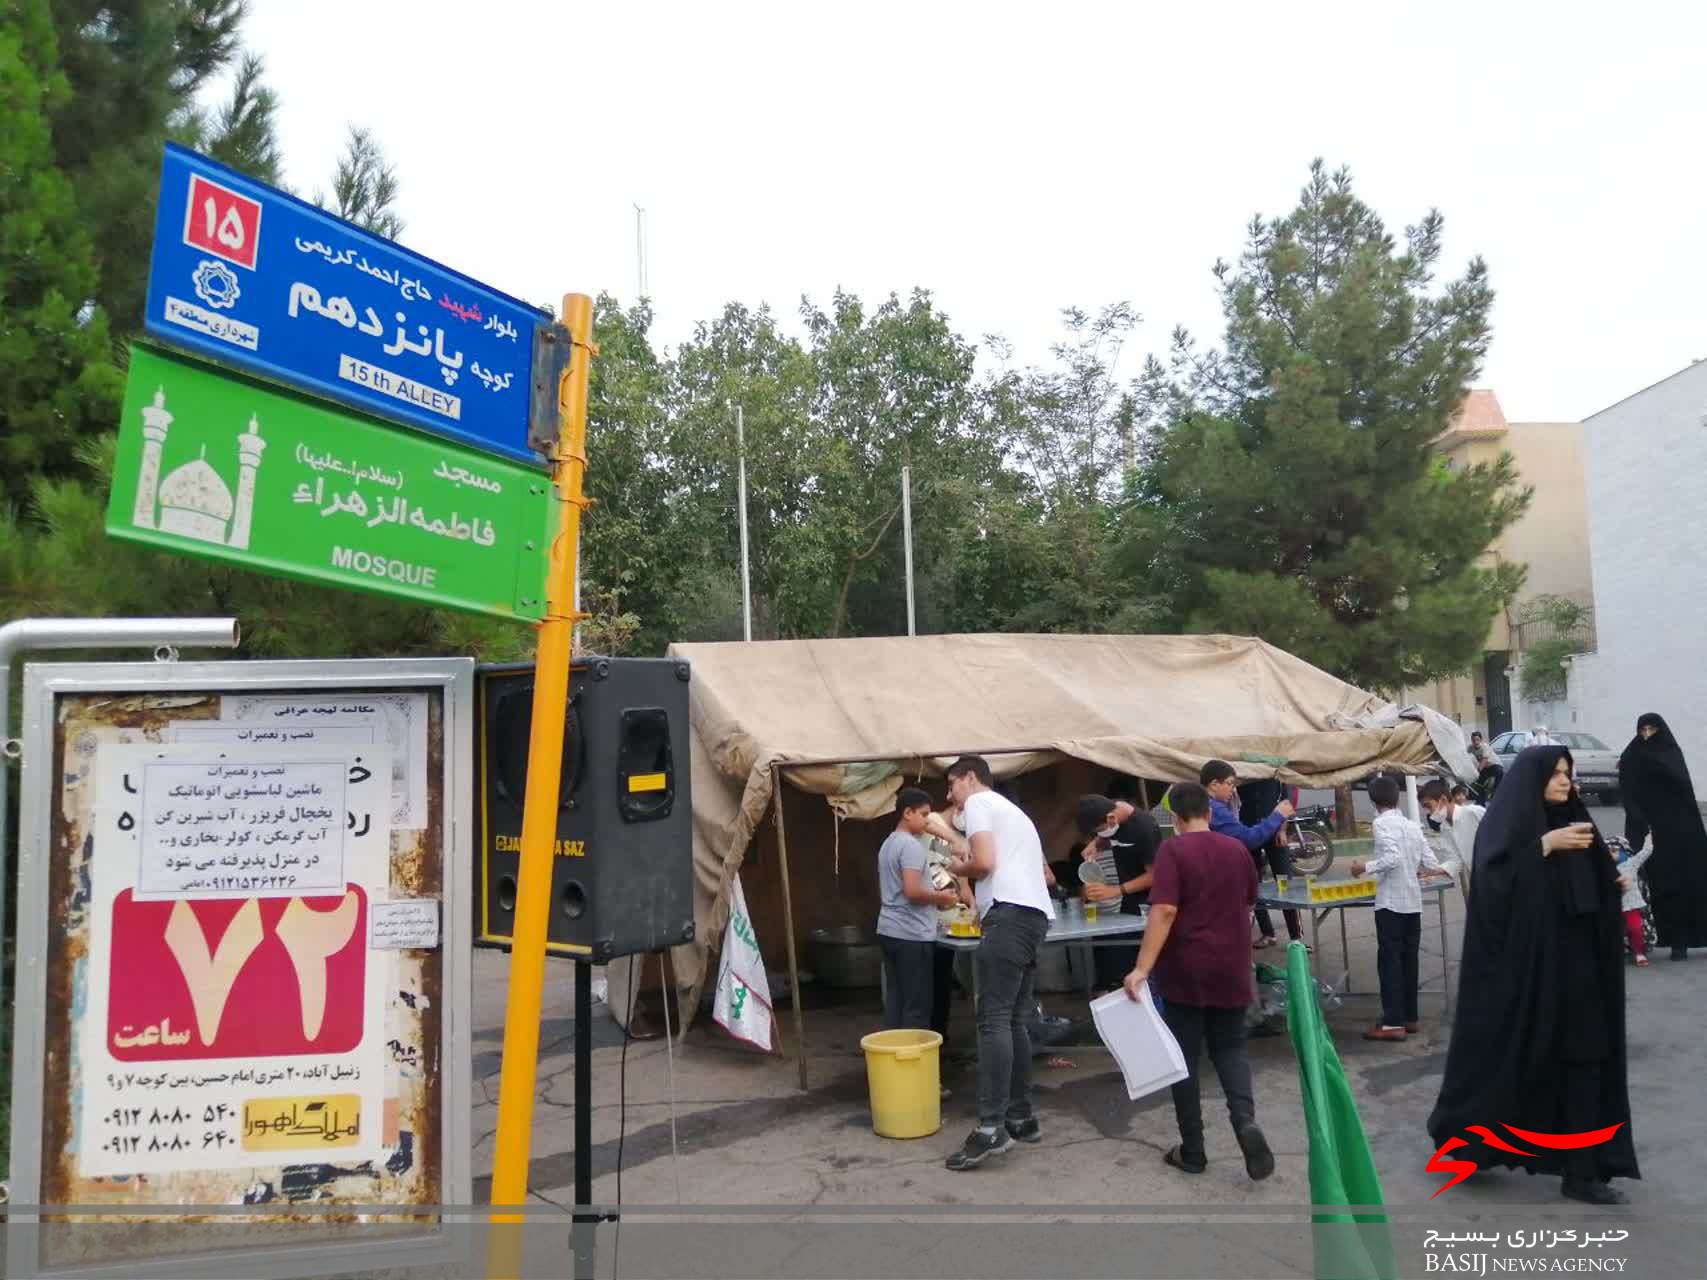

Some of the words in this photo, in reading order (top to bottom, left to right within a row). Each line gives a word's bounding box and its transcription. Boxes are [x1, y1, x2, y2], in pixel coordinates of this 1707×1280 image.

[204, 197, 245, 249] ۱۵
[295, 237, 357, 264] کریمی
[356, 259, 400, 286] احمد
[401, 278, 432, 300] حاج
[438, 294, 483, 322] شهید
[288, 281, 464, 386] پانزدهم
[484, 314, 518, 342] بلوار
[471, 361, 514, 392] کوچه
[349, 362, 369, 384] 15
[373, 369, 391, 392] th
[396, 380, 454, 413] ALLEY
[433, 461, 503, 494] مسجد
[293, 476, 407, 528] الزهراء
[409, 507, 496, 546] فاطمه
[331, 545, 437, 588] MOSQUE
[312, 705, 337, 716] لهجه
[341, 705, 375, 714] مکالمه
[237, 730, 278, 743] تعمیرات
[282, 732, 288, 742] و
[290, 729, 314, 740] نصب
[207, 766, 249, 780] تعمیرات
[253, 769, 258, 779] و
[261, 767, 285, 778] نصب
[168, 783, 221, 800] اتوماتیک
[224, 783, 282, 800] لباسشویی
[286, 783, 322, 799] ماشین
[154, 810, 175, 826] کن
[176, 810, 214, 826] شیرین
[217, 807, 238, 823] آب
[248, 806, 286, 825] فریزر
[289, 806, 333, 823] یخچال
[307, 828, 328, 841] آب
[166, 858, 192, 873] شود
[195, 859, 216, 871] می
[219, 853, 266, 870] پذیرفته
[269, 853, 300, 869] منزل
[304, 854, 320, 869] در
[113, 1017, 191, 1049] ساعت
[107, 1073, 115, 1088] ۹
[125, 1073, 135, 1087] ۷
[136, 1072, 168, 1090] کوچه
[231, 1069, 254, 1086] امام
[255, 1069, 285, 1085] متری
[330, 1064, 361, 1081] زنبیل
[116, 1079, 123, 1091] و
[169, 1075, 189, 1088] بین
[148, 1105, 191, 1124] ۸۰۸۰
[203, 1103, 236, 1123] ۵۴۰
[244, 1103, 297, 1137] اهورا
[286, 1101, 360, 1142] املاک
[148, 1132, 190, 1152] ۸۰۸۰
[203, 1130, 235, 1150] ۶۴۰
